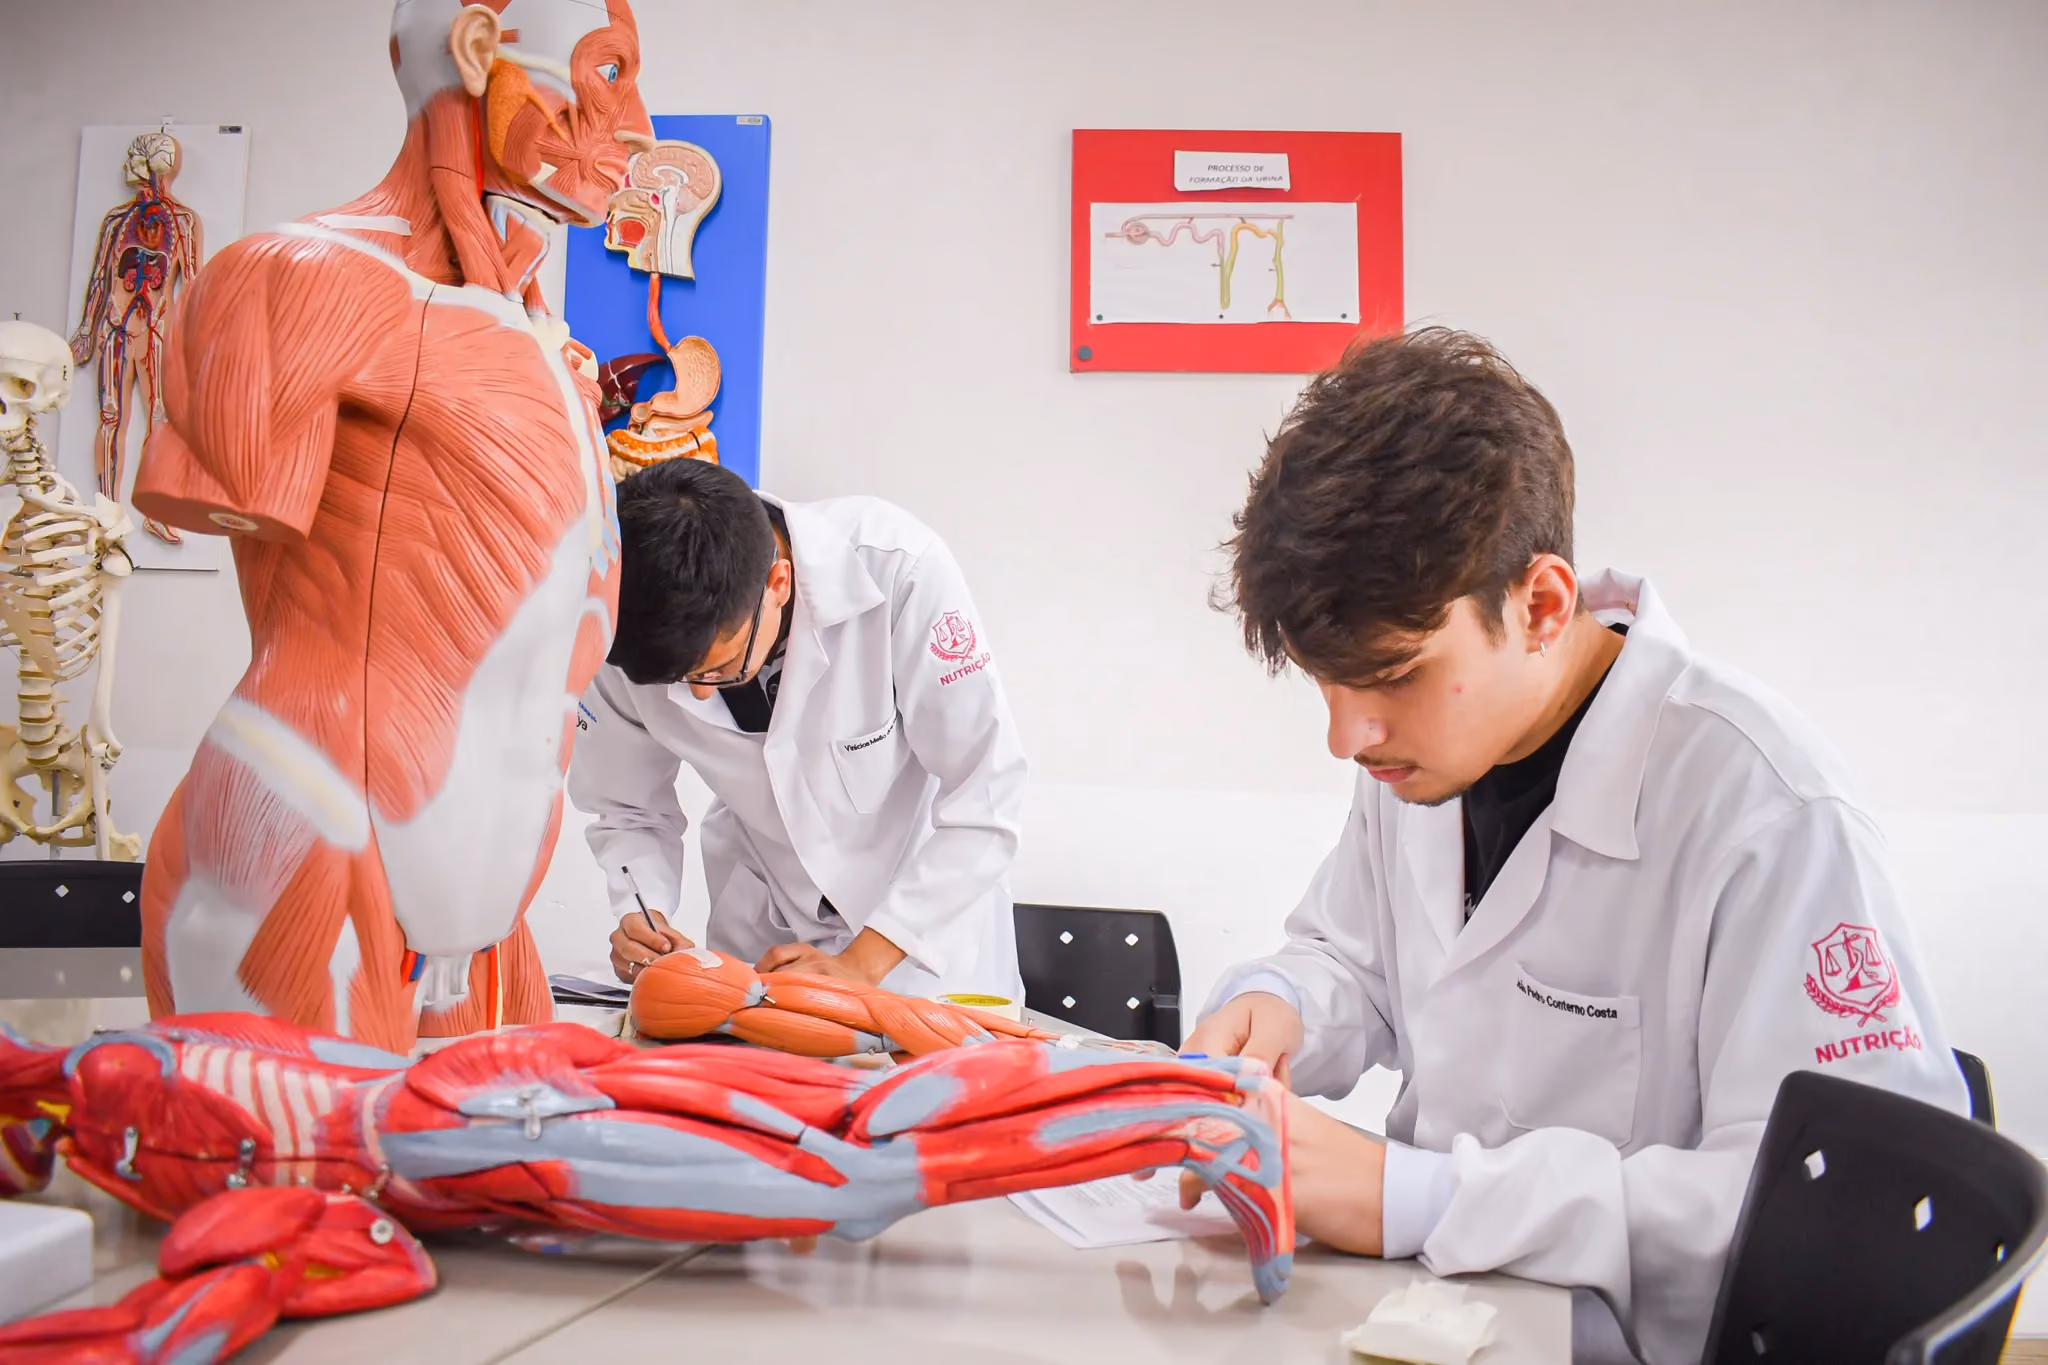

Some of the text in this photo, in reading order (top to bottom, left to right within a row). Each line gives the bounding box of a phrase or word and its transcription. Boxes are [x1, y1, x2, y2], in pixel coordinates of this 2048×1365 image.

[1189, 175, 1238, 184] FORMAÇÃO
[1207, 164, 1264, 173] PROCESSO DE
[940, 652, 991, 686] NUTRIÇÃO
[1546, 995, 1585, 1016] Conterno
[1586, 1004, 1618, 1019] Costa
[1815, 1025, 1922, 1064] NUTRIÇÃO
